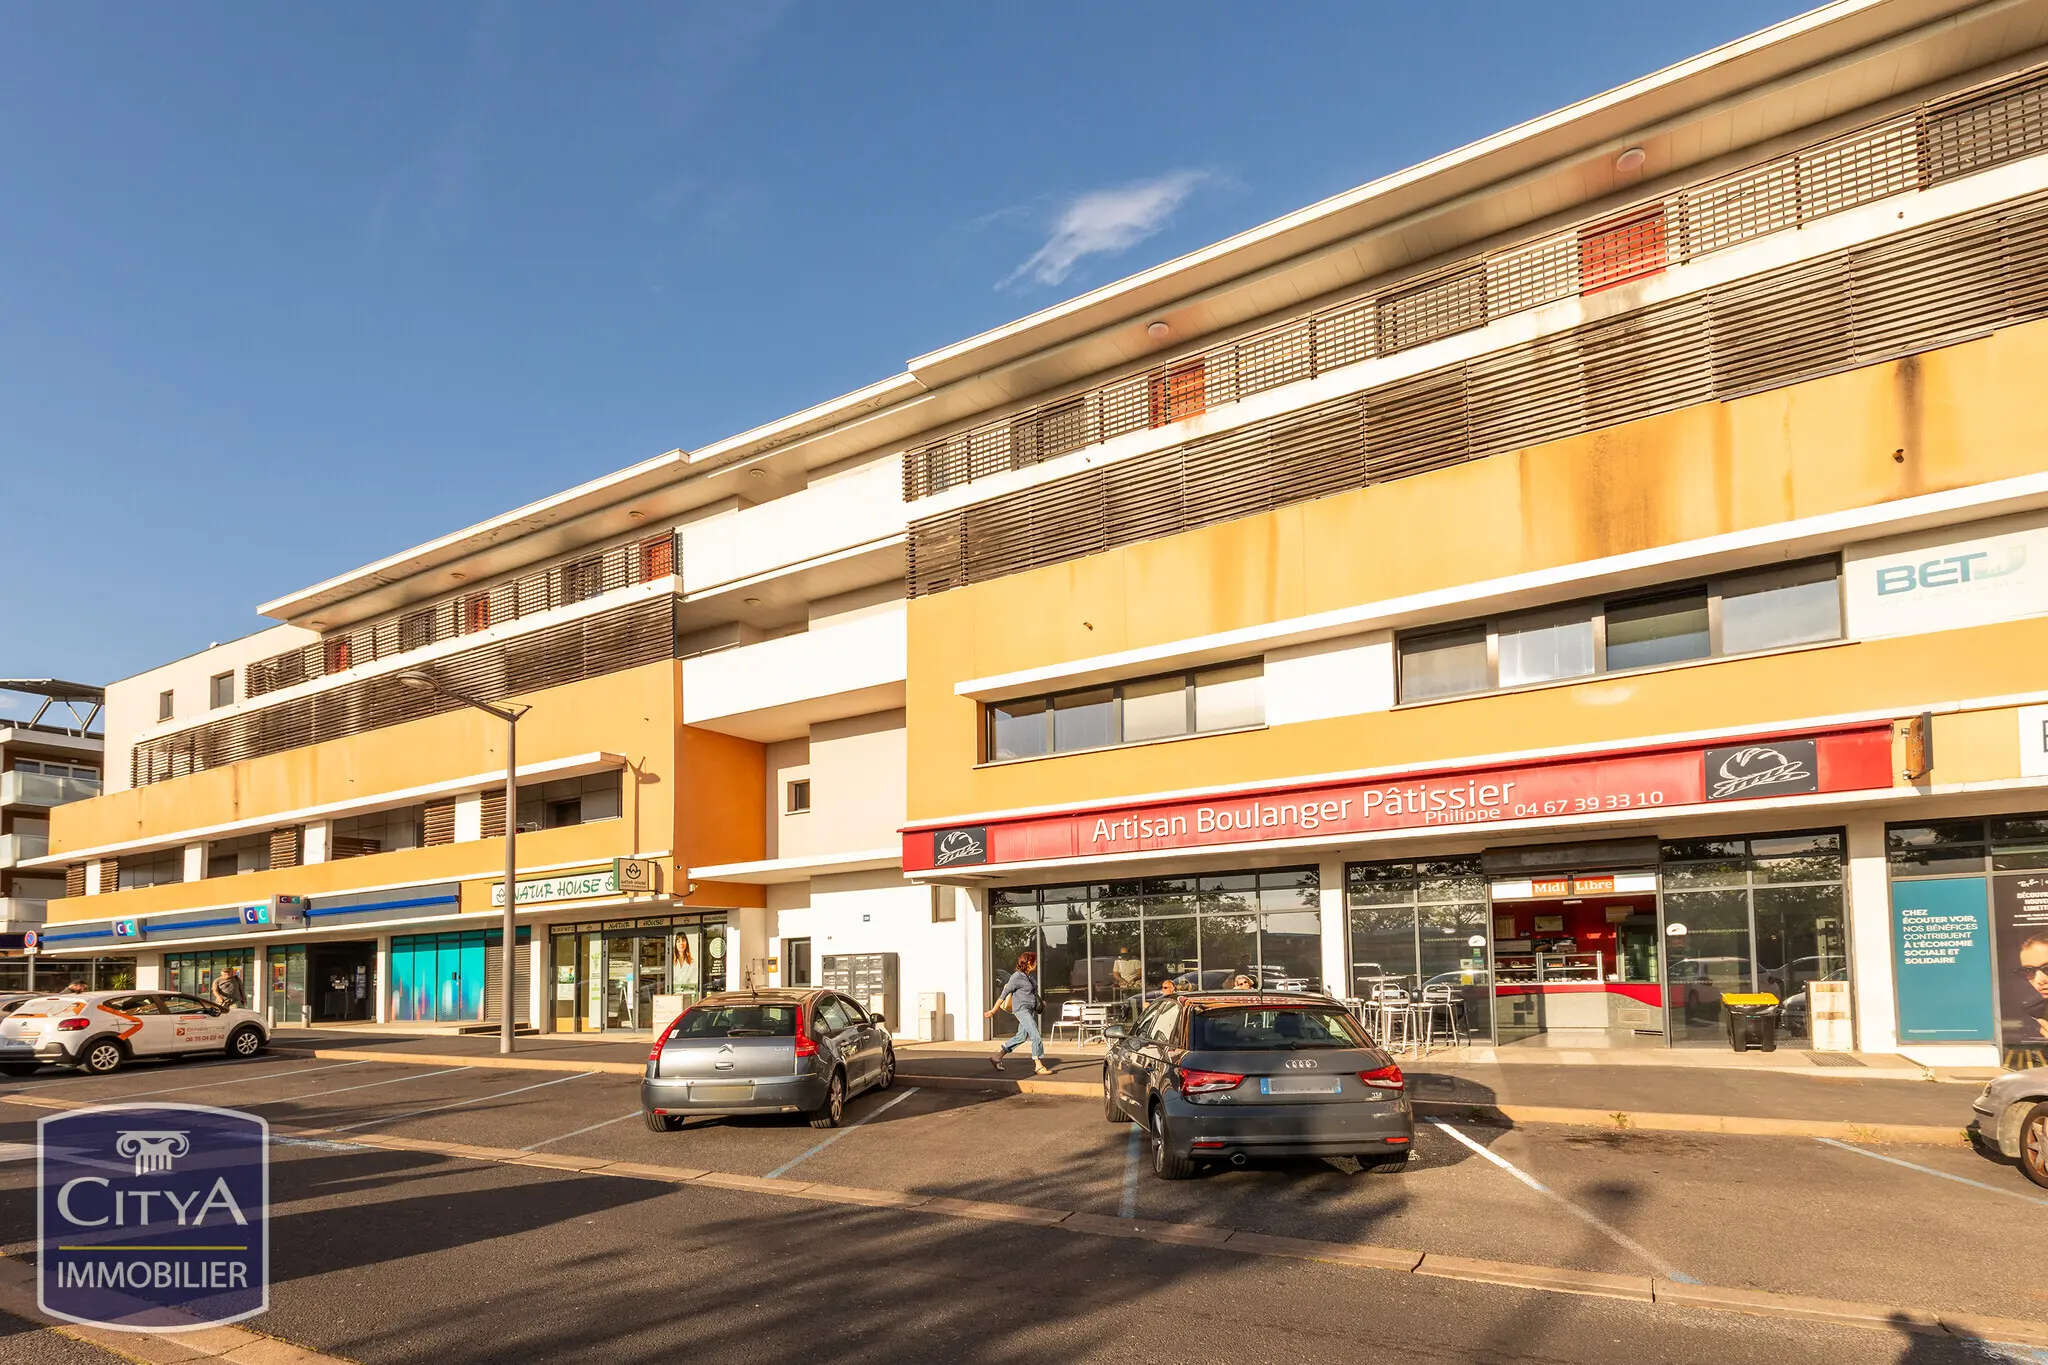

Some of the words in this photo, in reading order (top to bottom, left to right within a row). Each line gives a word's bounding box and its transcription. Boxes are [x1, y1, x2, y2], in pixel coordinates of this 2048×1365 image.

[1092, 815, 1188, 843] Artisan
[1196, 798, 1352, 830] Boulanger
[1363, 779, 1516, 819] Pâtissier
[1425, 807, 1501, 825] Philippe
[1514, 802, 1539, 817] 04
[1544, 799, 1568, 814] 67
[1575, 797, 1600, 812] 39
[1605, 794, 1631, 809] 33
[1637, 791, 1664, 806] 10
[557, 878, 602, 896] HOUSE
[1533, 882, 1566, 893] Midi
[1575, 880, 1613, 891] Libre
[246, 908, 267, 922] CIC
[1902, 916, 1948, 924] ÉCOUTER
[117, 922, 134, 935] CIC
[1926, 922, 1978, 931] BÉNÉFICES
[1903, 931, 1972, 940] CONTRIBUENT
[1904, 948, 1946, 956] SOCIALE
[1905, 956, 1956, 964] SOLIDAIRE
